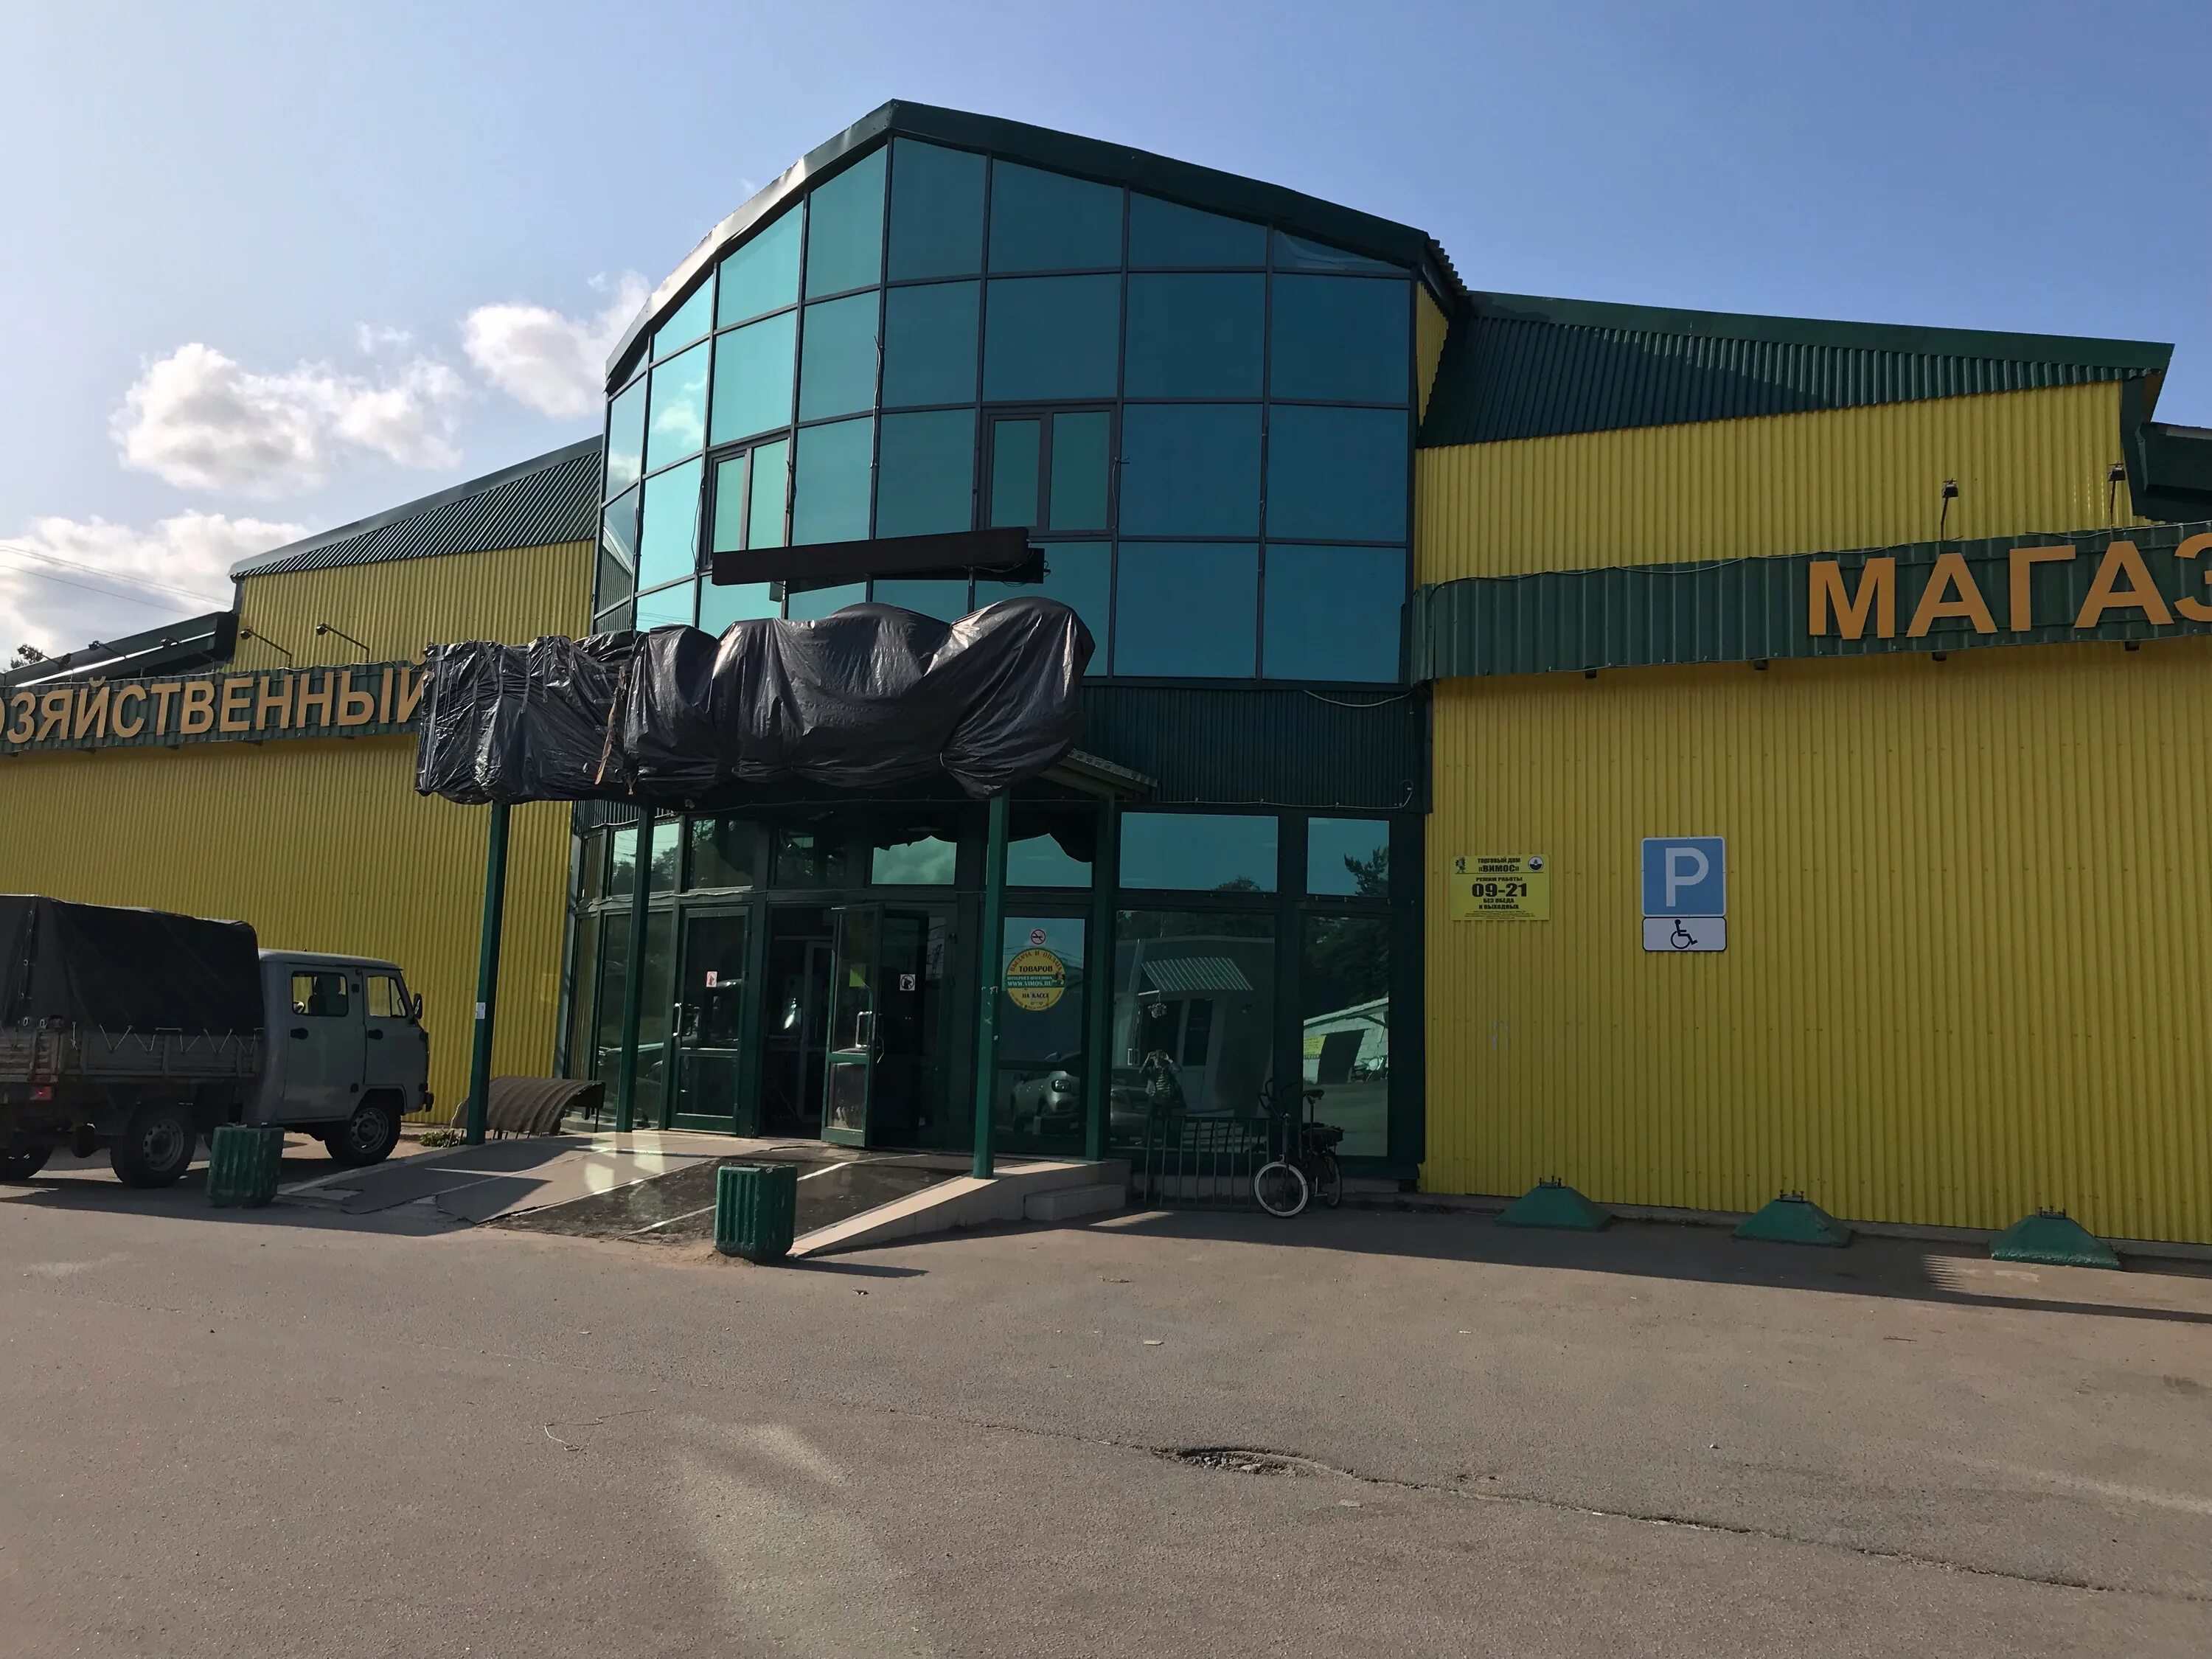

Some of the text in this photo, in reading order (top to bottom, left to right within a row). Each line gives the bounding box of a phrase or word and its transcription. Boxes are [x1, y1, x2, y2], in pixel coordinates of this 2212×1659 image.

[0, 654, 427, 744] ЗЯЙСТВЕННЫЙ
[1472, 883, 1527, 897] 09-21
[1666, 847, 1709, 907] P
